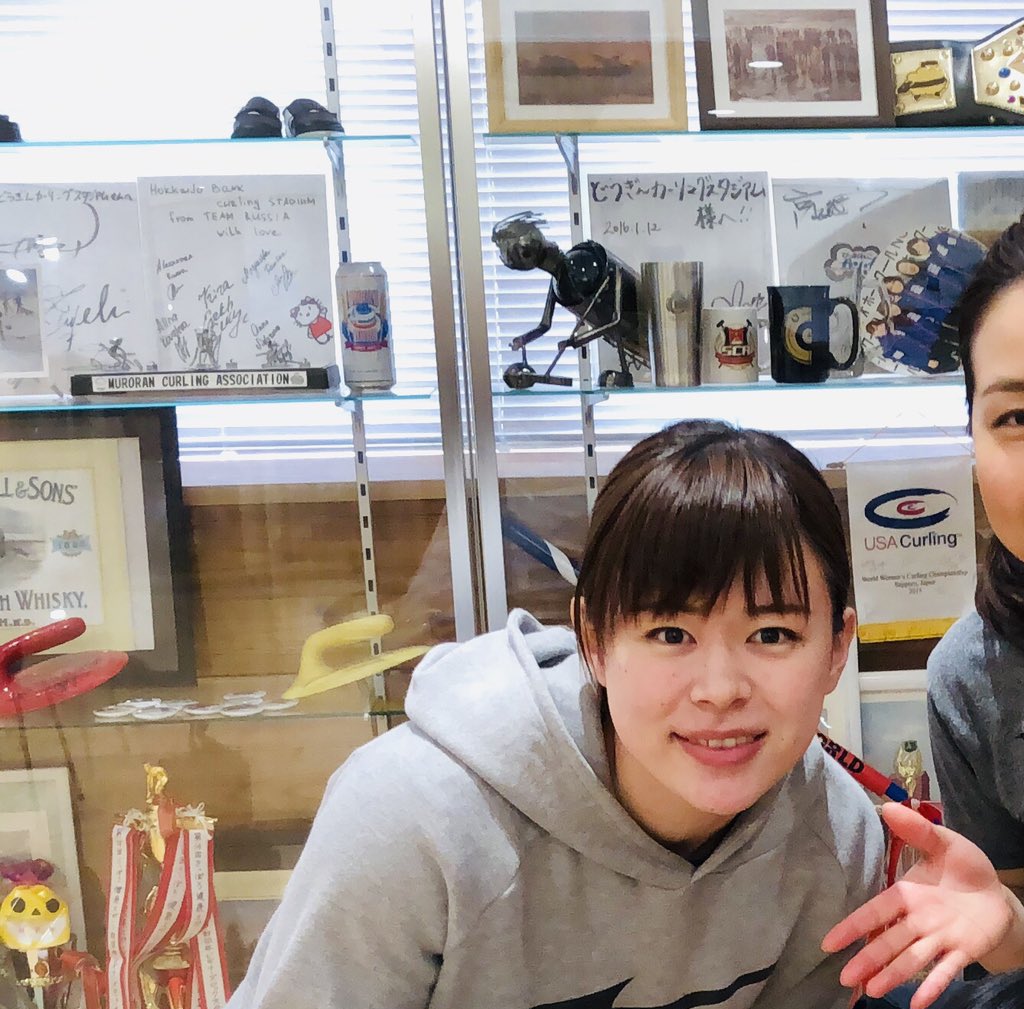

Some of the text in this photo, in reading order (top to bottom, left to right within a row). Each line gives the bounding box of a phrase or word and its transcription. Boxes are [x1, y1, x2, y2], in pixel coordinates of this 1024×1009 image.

[108, 373, 290, 389] MURORAN CURLING ASSOCIATION
[864, 532, 957, 551] USA Curling
